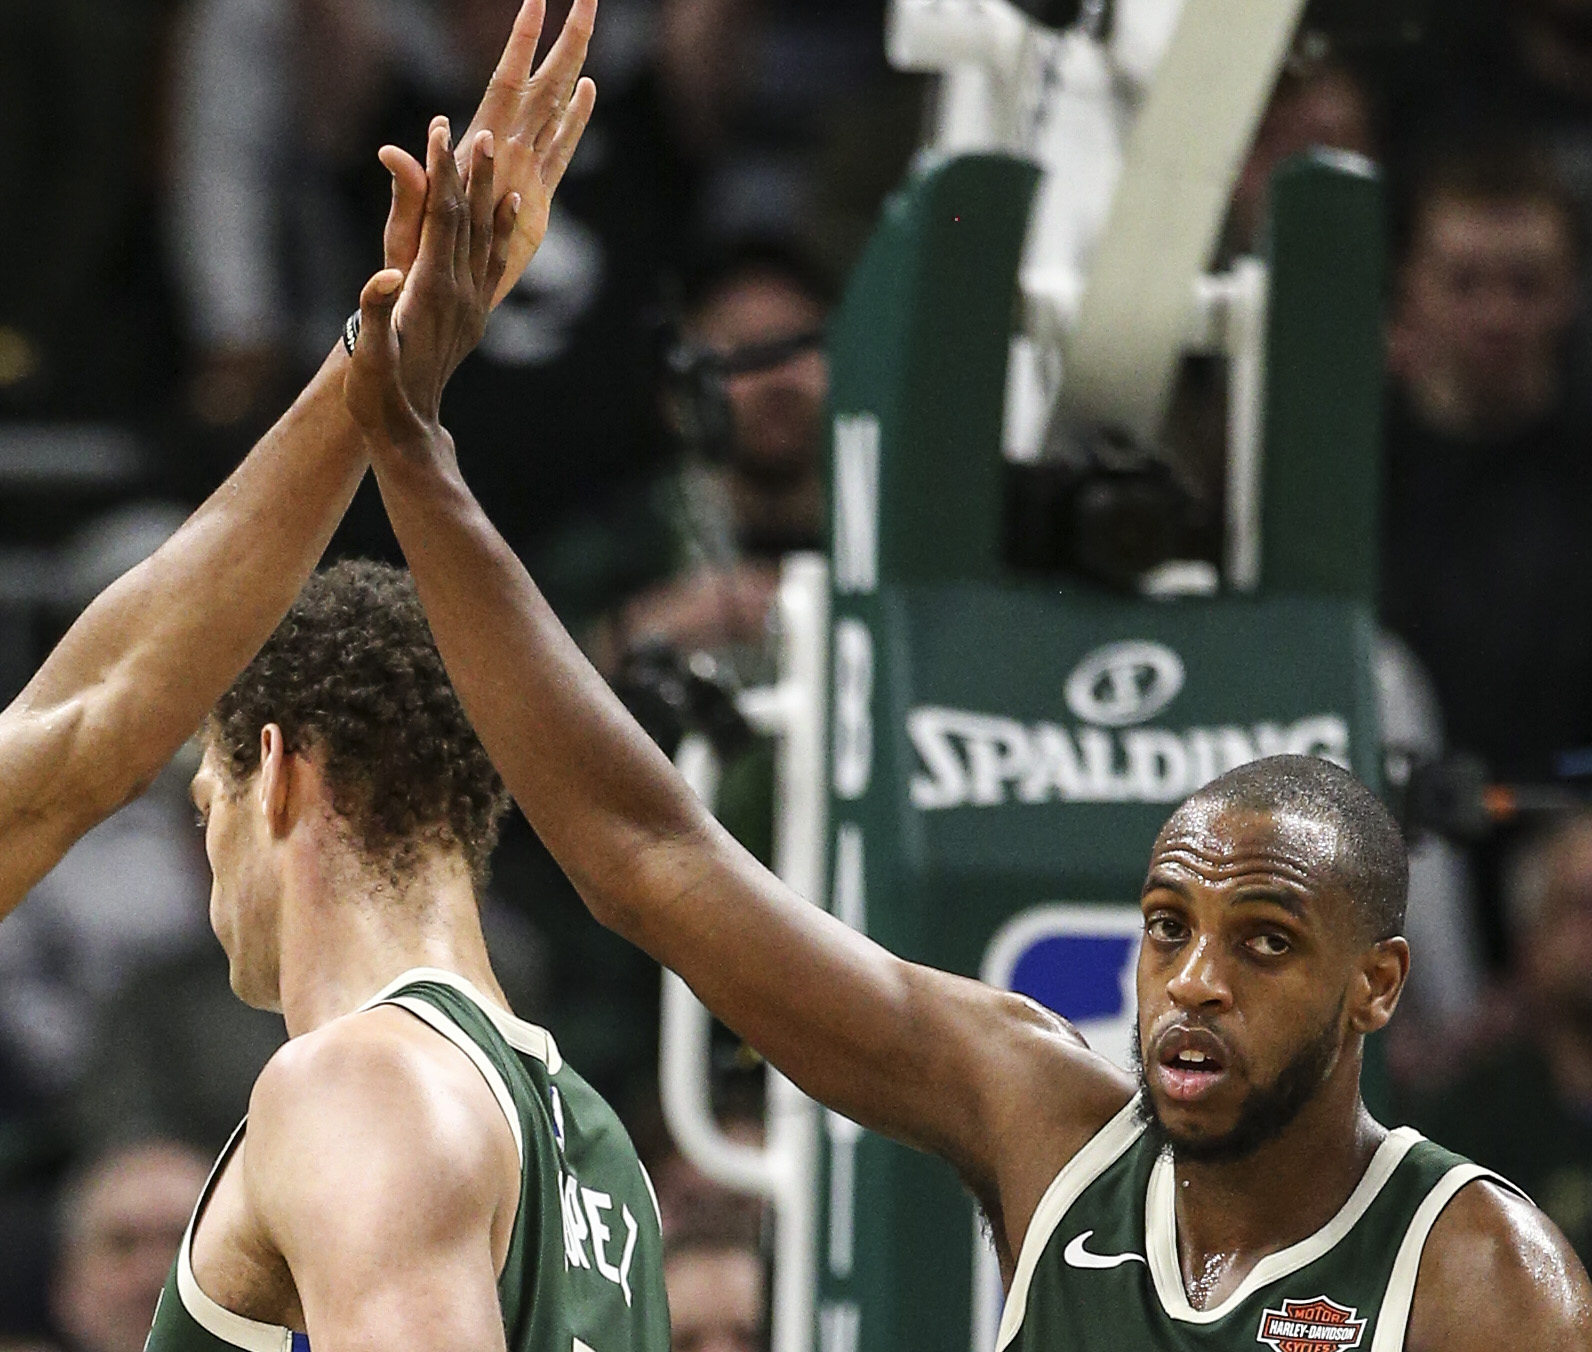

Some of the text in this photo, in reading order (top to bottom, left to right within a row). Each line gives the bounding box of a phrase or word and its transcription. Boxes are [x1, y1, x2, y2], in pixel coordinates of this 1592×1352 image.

[908, 704, 1351, 809] SPALDING
[1294, 1305, 1343, 1323] MOTOR
[1268, 1319, 1357, 1341] HARLEY-DAVIDSON
